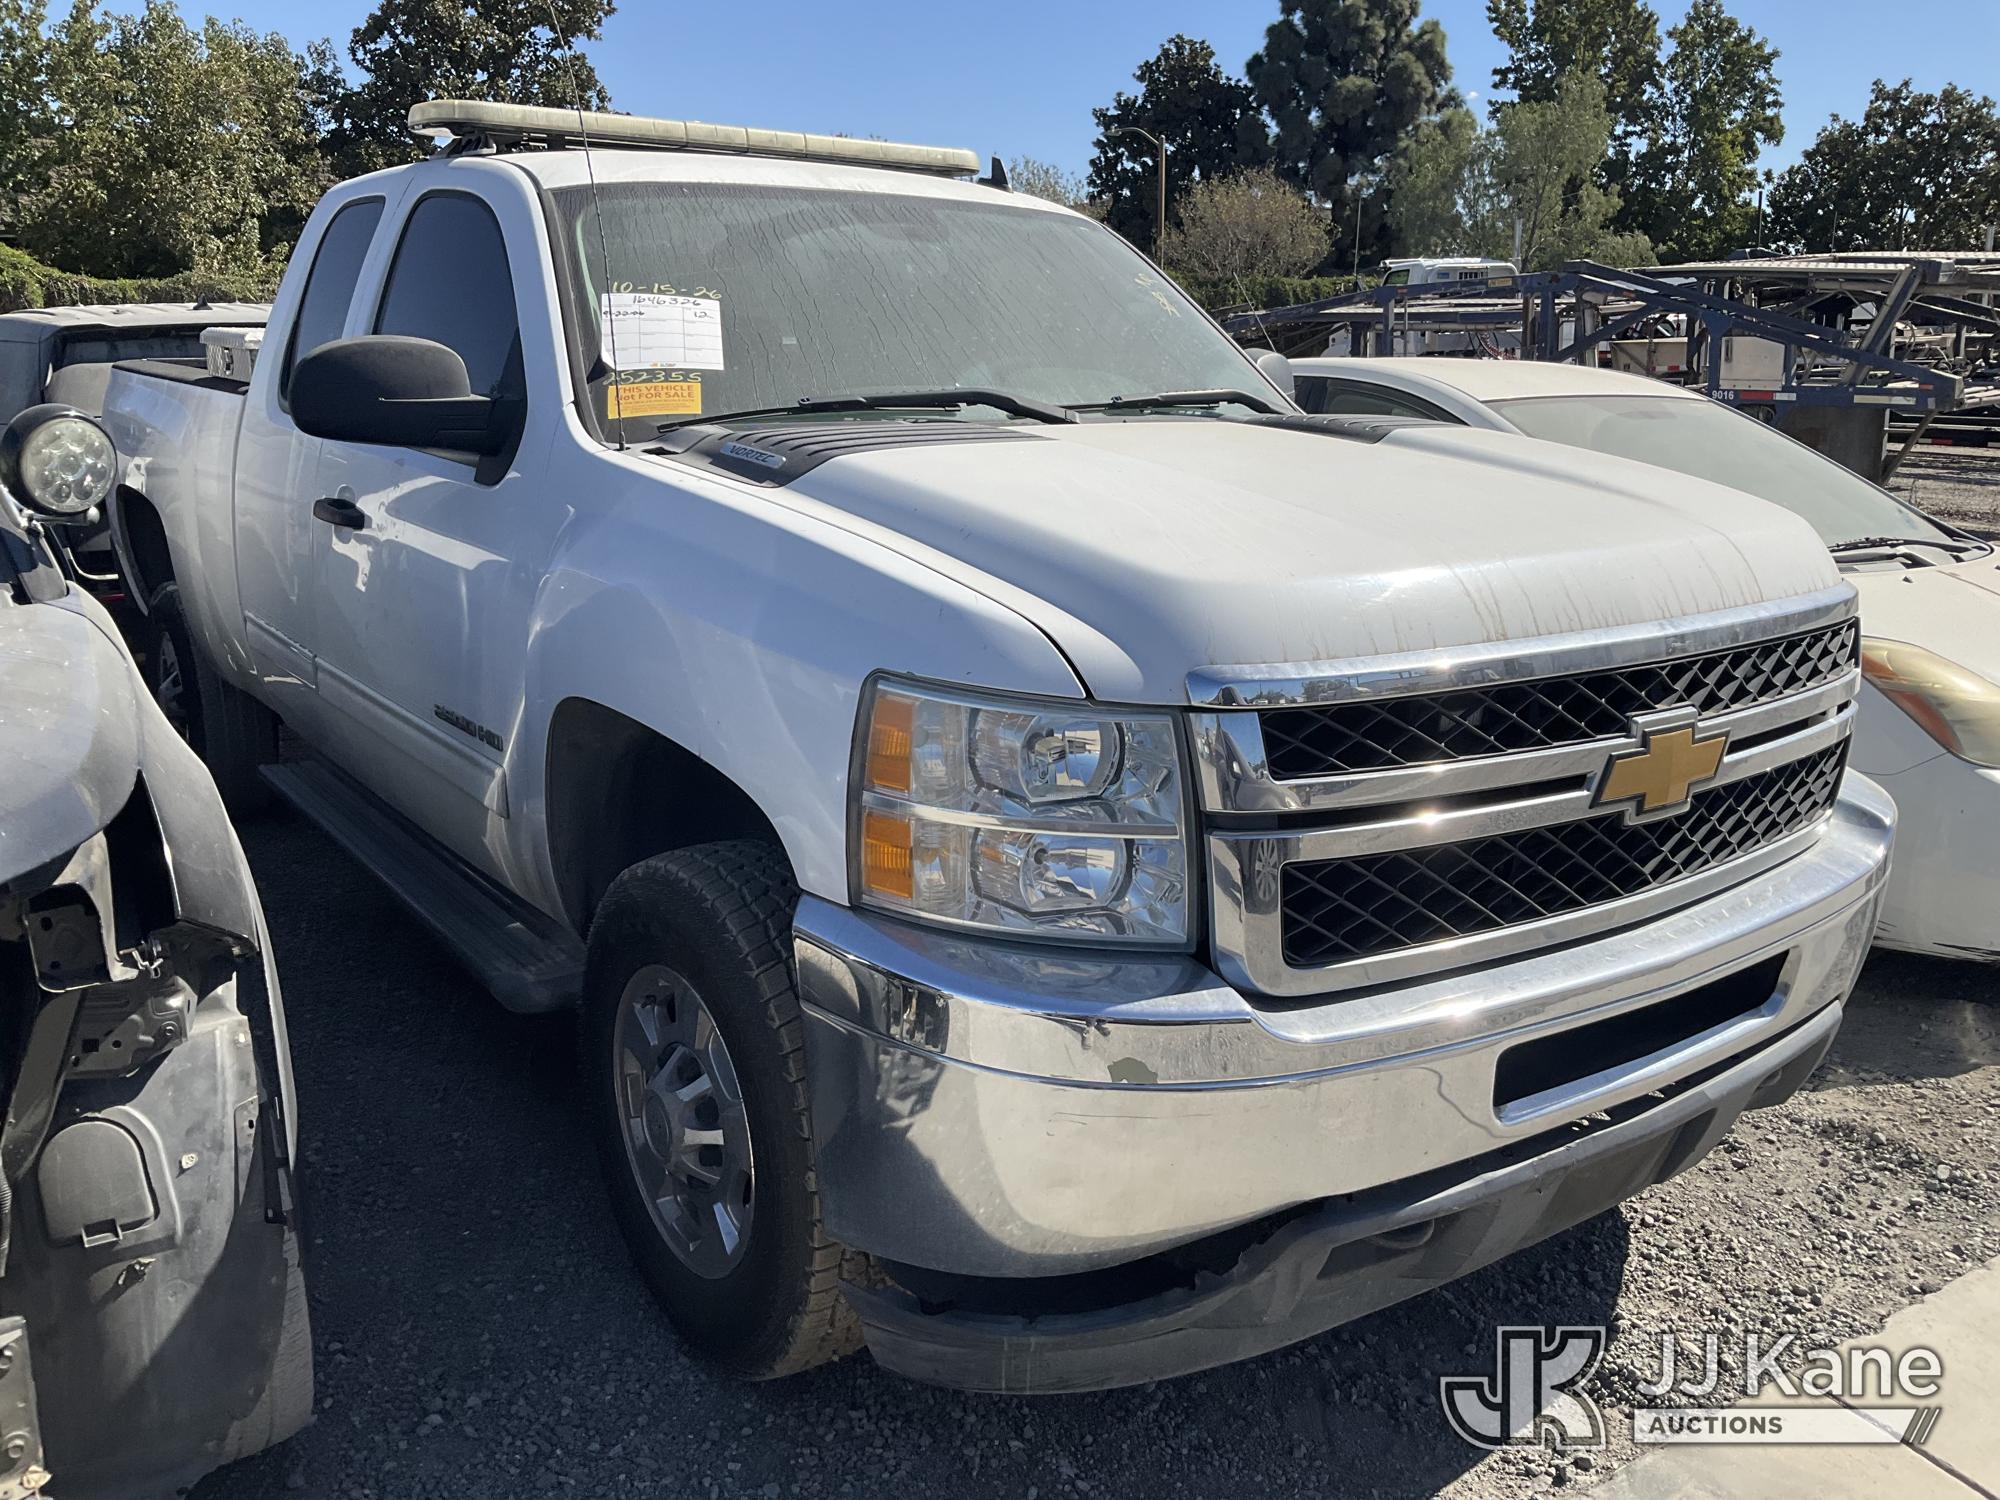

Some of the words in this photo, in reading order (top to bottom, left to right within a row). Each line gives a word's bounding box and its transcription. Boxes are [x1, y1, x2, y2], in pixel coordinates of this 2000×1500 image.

[638, 392, 662, 400] FOR
[1712, 390, 1734, 400] 9016
[729, 445, 775, 462] VORTEC
